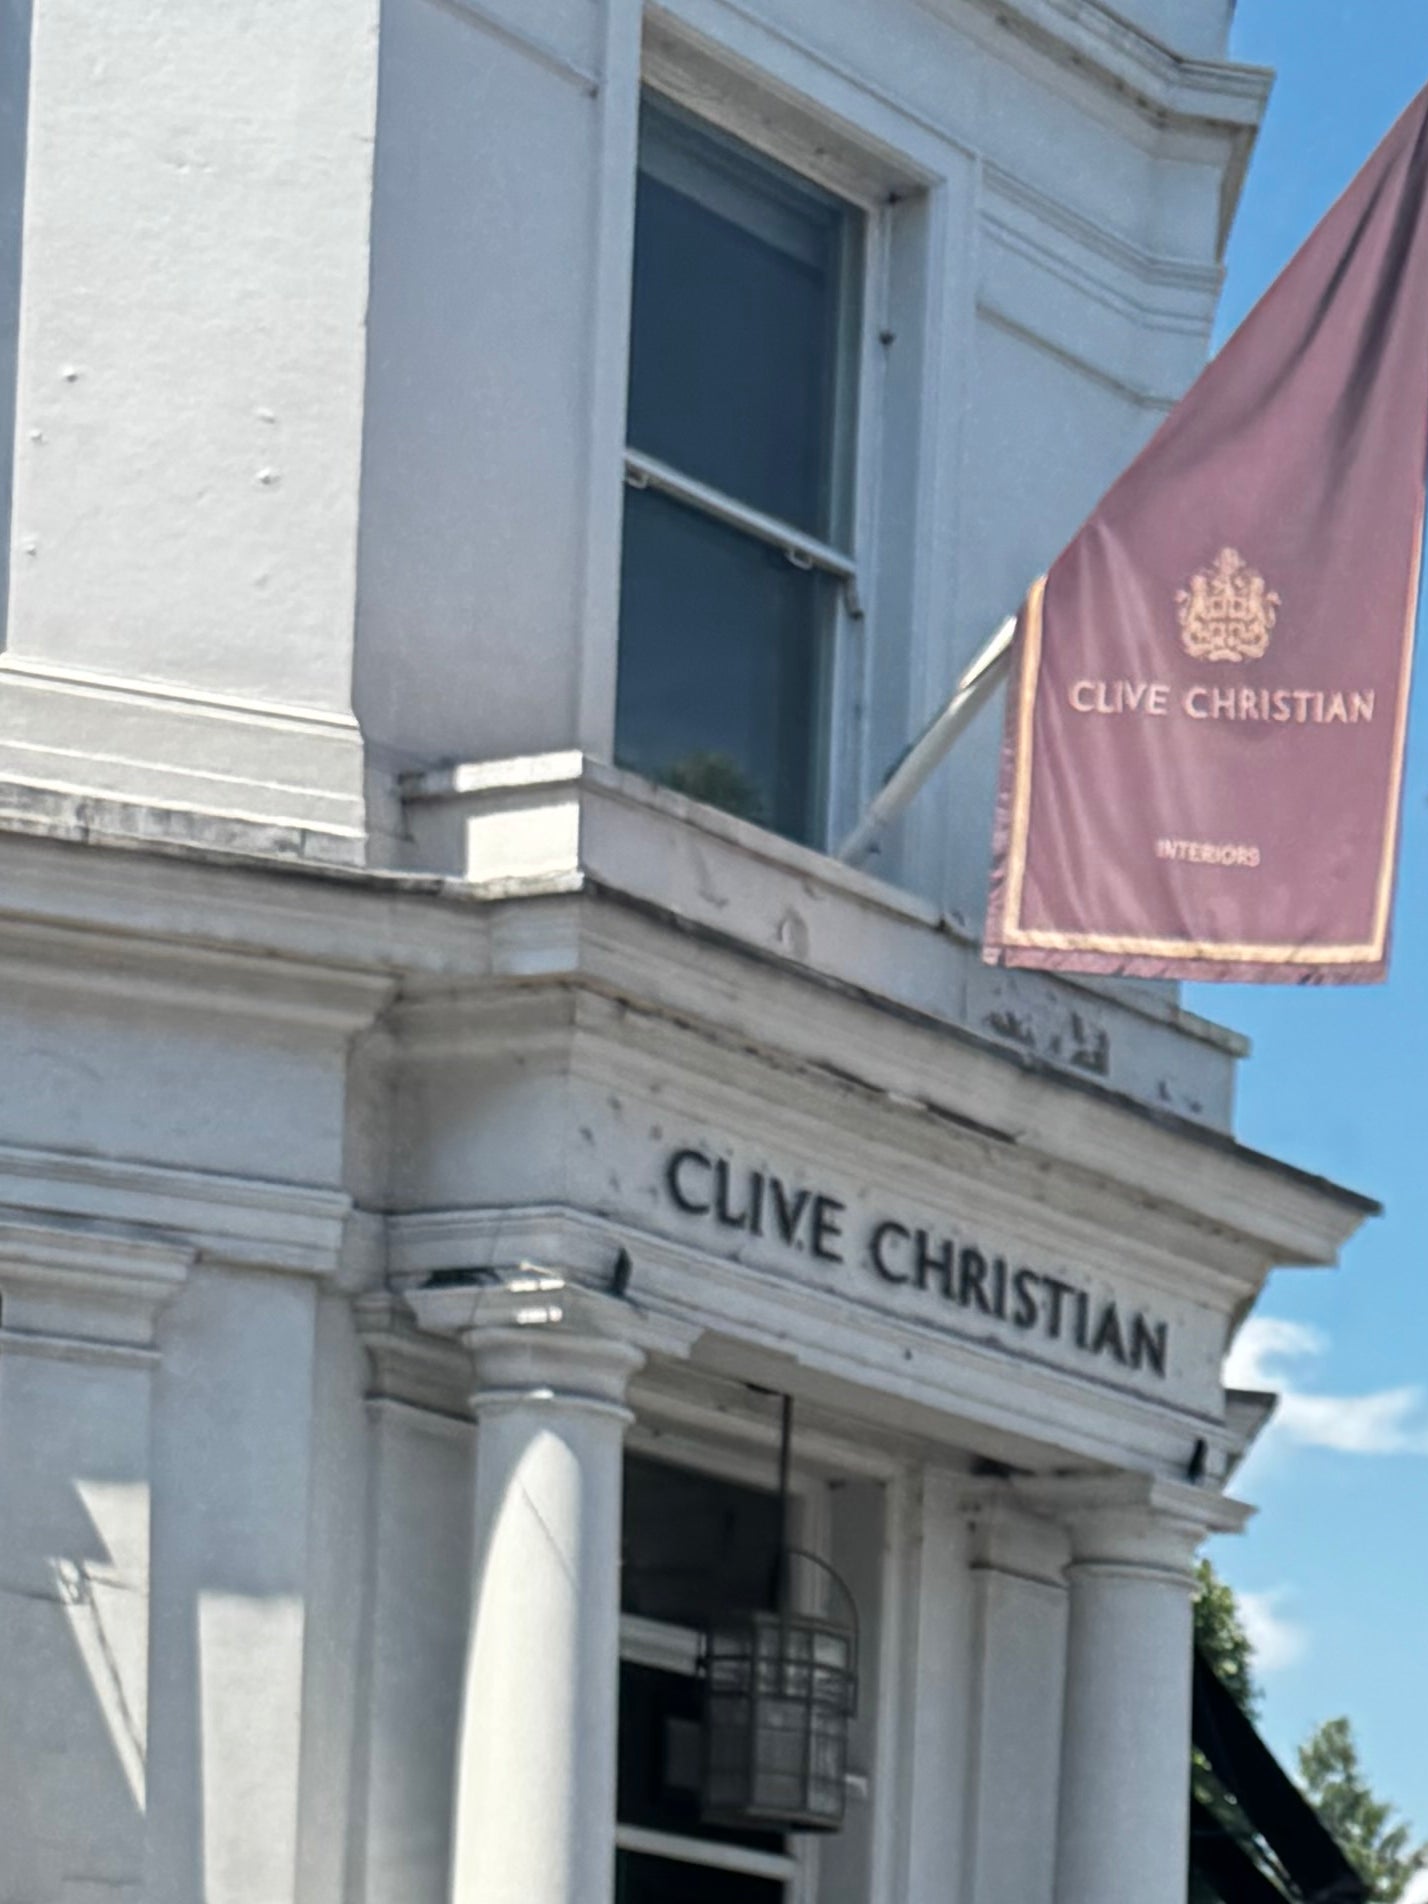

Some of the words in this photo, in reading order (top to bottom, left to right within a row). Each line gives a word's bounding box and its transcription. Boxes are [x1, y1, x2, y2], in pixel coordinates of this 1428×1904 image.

[1068, 679, 1171, 716] CLIVE
[1184, 686, 1376, 724] CHRISTIAN
[1156, 839, 1261, 867] INTERIORS
[666, 1148, 846, 1263] CLIVE
[870, 1220, 1168, 1379] CHRISTIAN
